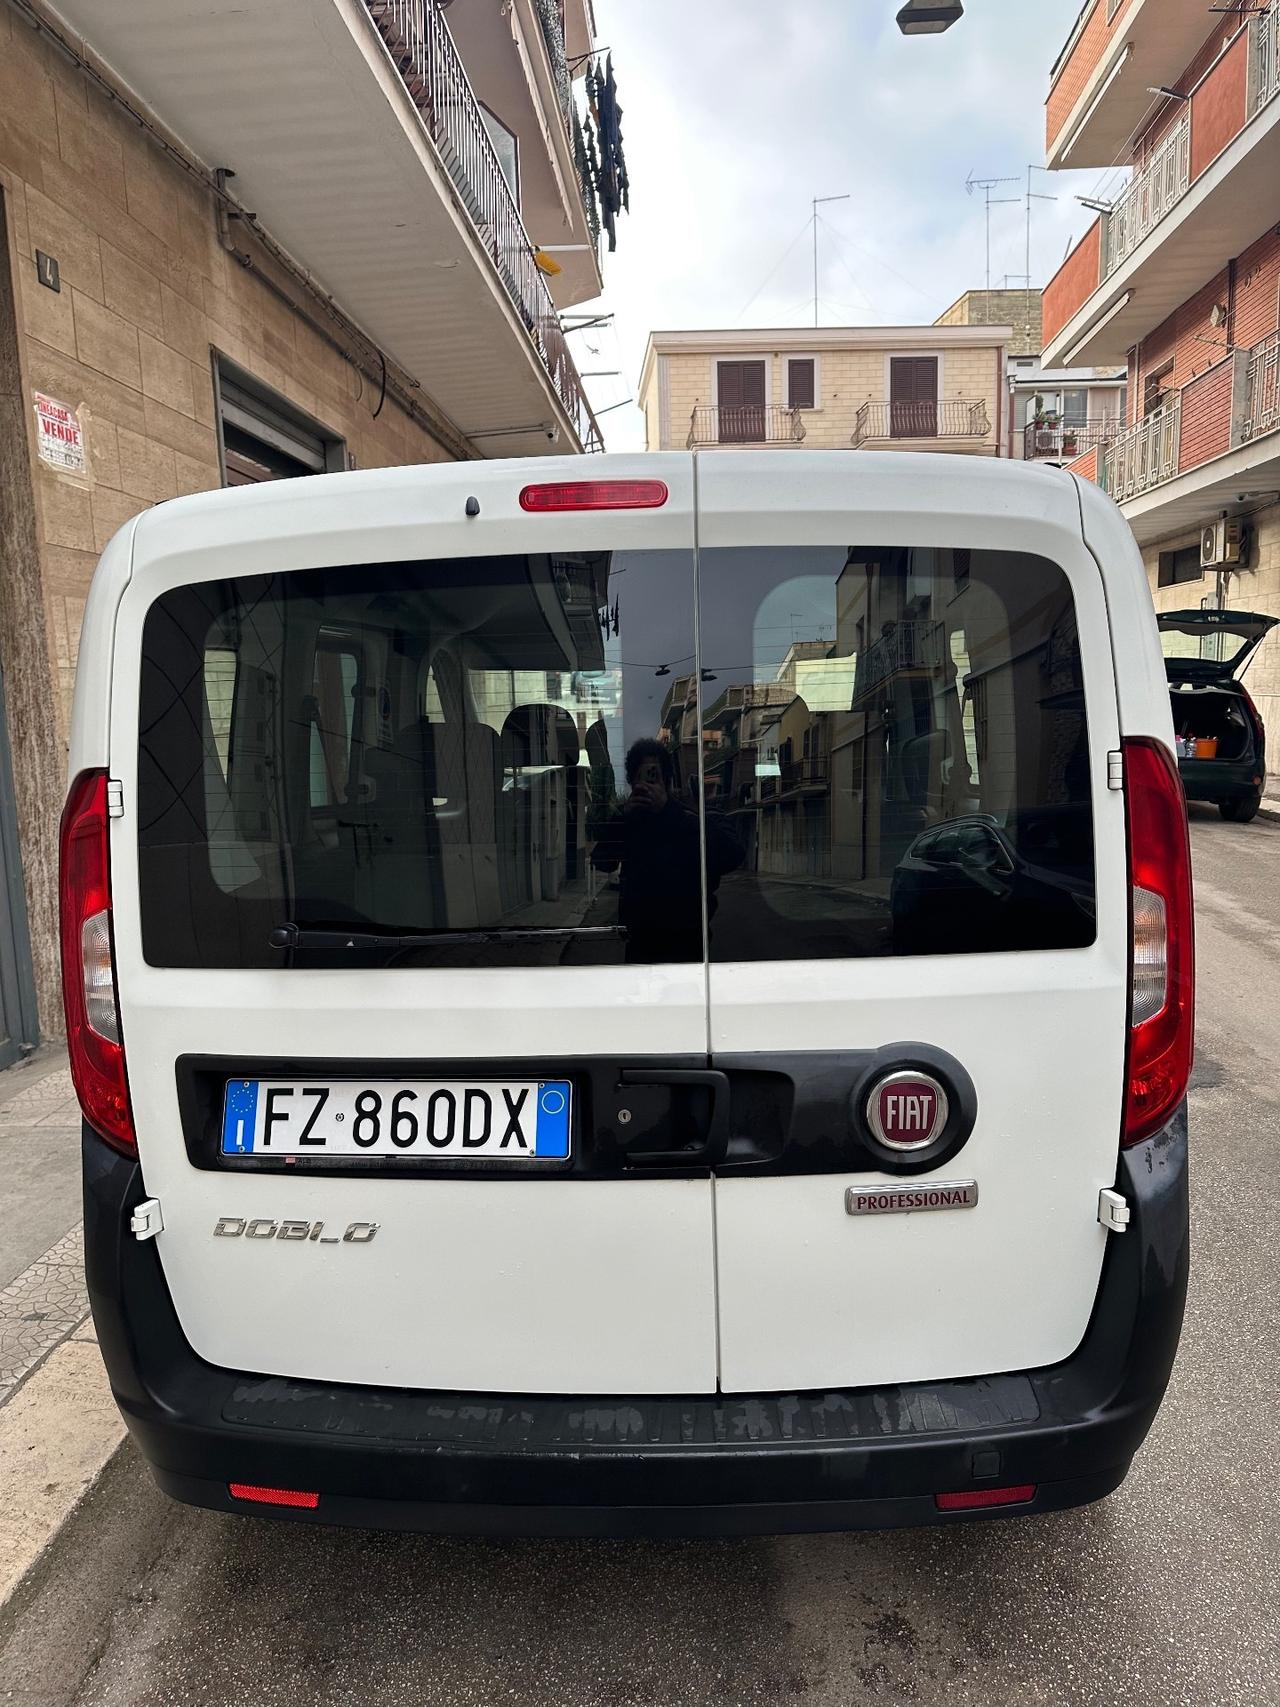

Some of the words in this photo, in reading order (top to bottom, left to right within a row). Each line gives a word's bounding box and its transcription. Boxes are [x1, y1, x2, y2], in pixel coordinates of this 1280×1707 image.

[46, 258, 53, 286] 4
[42, 418, 80, 445] VENDE
[886, 1095, 932, 1130] FIAT
[857, 1191, 970, 1209] PROFESSIONAL
